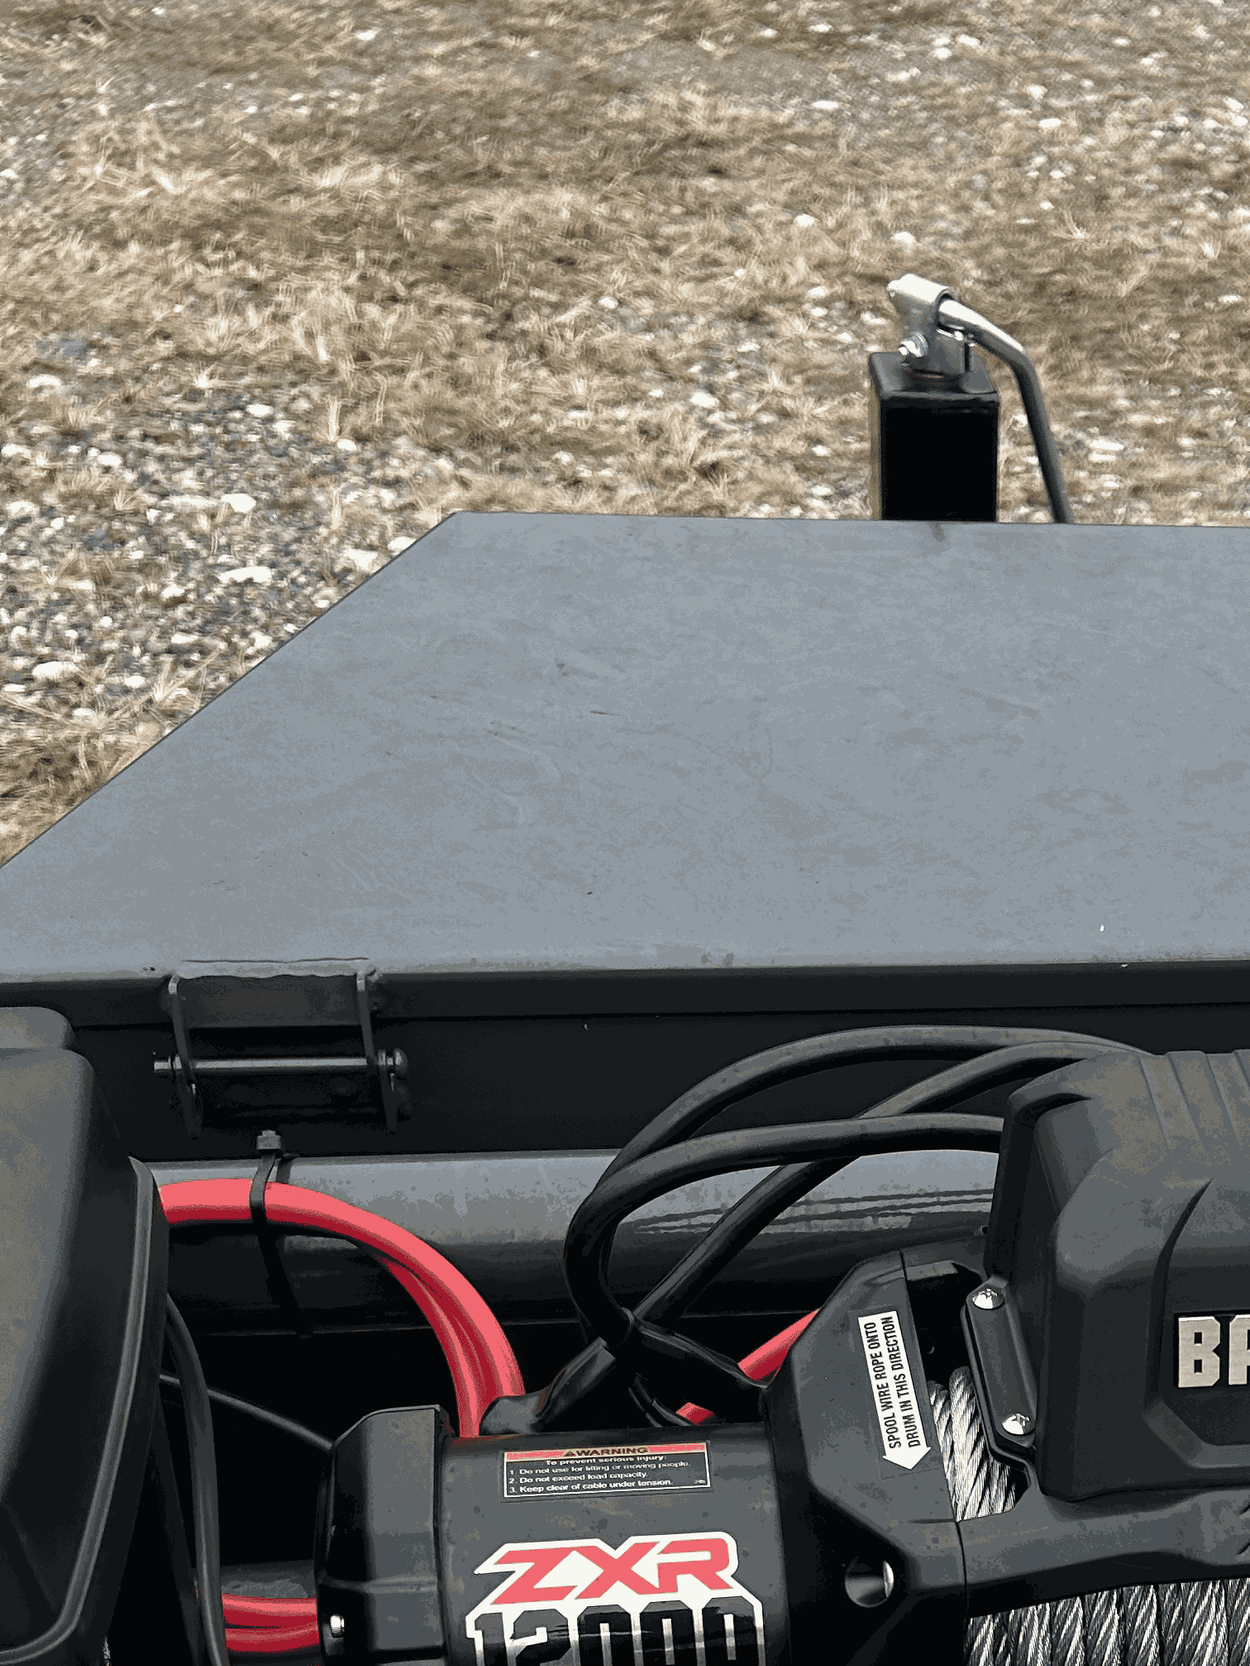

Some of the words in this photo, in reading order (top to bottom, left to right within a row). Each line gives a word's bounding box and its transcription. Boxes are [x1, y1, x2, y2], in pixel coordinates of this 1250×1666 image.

[864, 1322, 881, 1350] ONTO
[880, 1316, 905, 1372] DIRECTION
[870, 1351, 887, 1380] ROPE
[877, 1382, 894, 1412] WIRE
[894, 1373, 909, 1399] THIS
[898, 1399, 913, 1412] IN
[883, 1412, 902, 1449] SPOOL
[902, 1413, 921, 1448] DRUM
[560, 1458, 596, 1466] prevent
[576, 1446, 648, 1457] WARNING
[552, 1474, 585, 1482] exceed
[585, 1464, 610, 1472] lifting
[623, 1462, 657, 1470] moving
[519, 1485, 544, 1493] Keep
[546, 1484, 569, 1492] clear
[609, 1480, 636, 1488] under
[637, 1479, 673, 1487] tension.
[489, 1537, 734, 1606] ZXR
